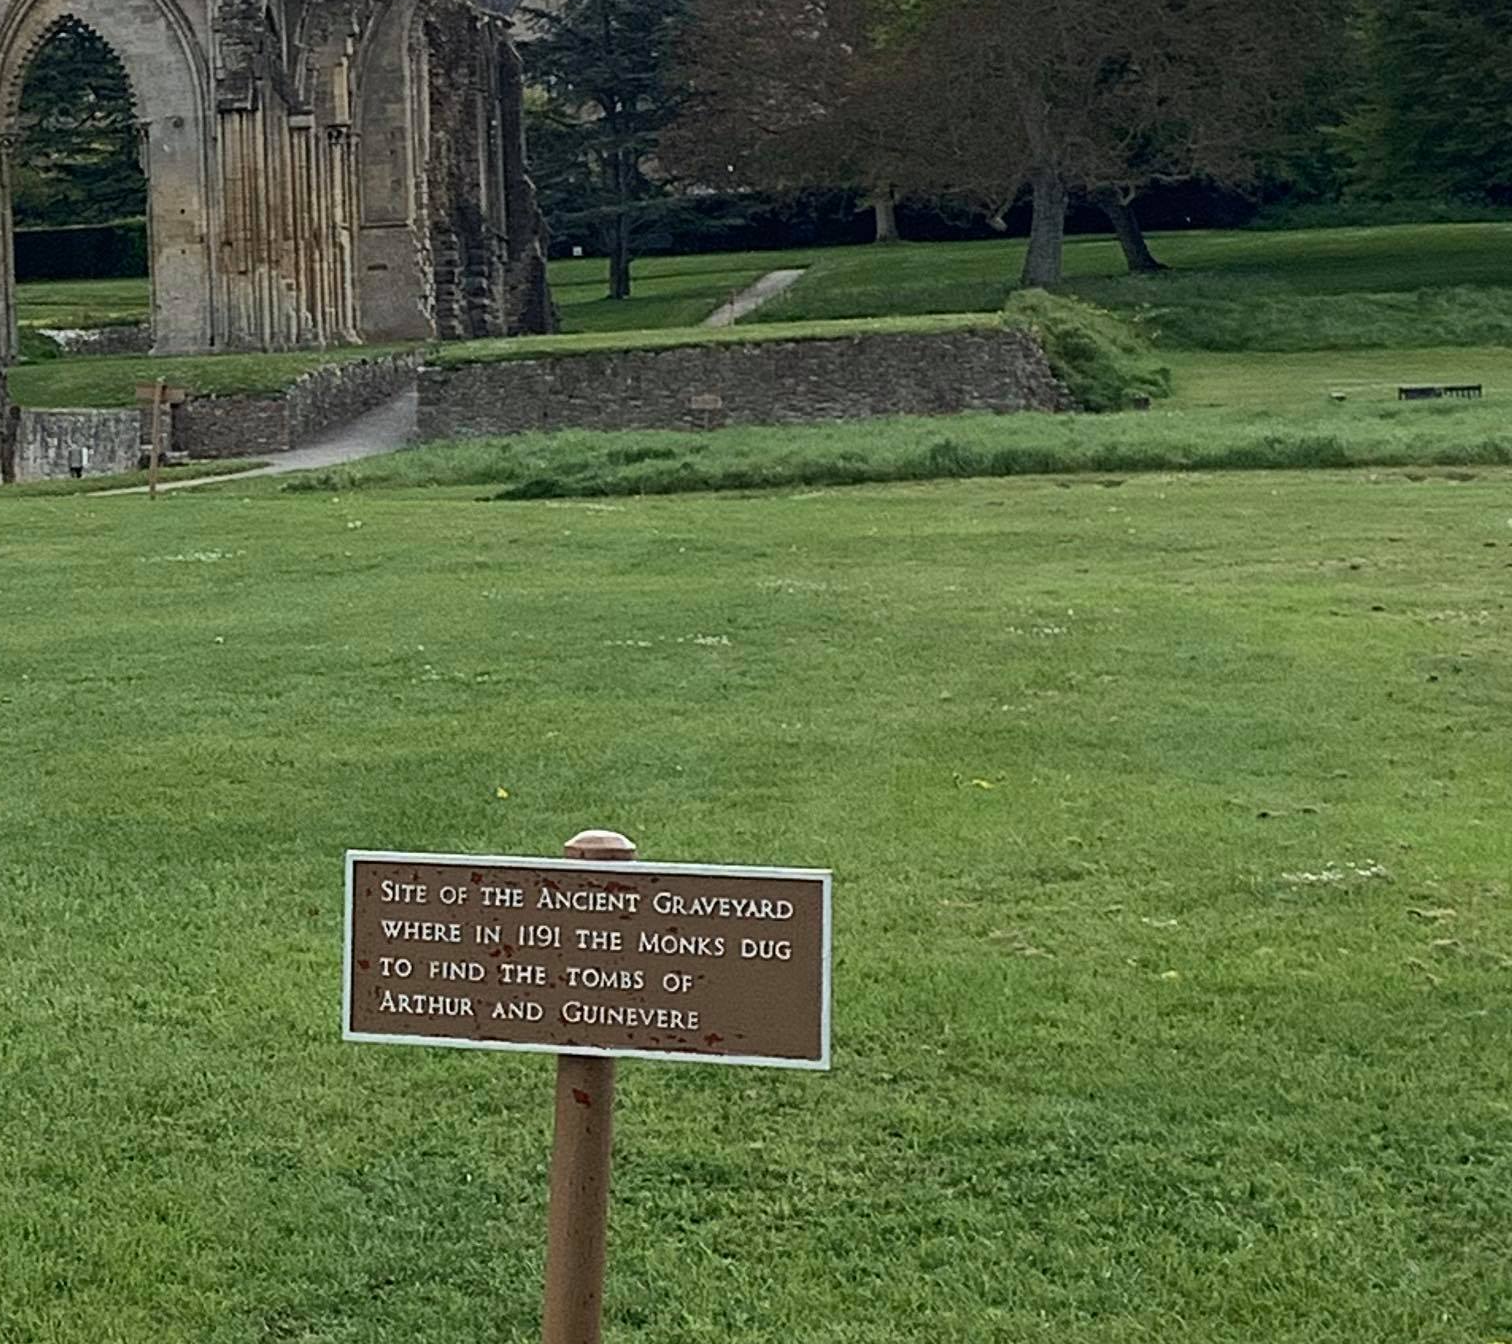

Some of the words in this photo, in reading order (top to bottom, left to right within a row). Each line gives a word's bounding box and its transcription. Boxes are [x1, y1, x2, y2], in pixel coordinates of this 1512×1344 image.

[381, 880, 427, 903] SITE
[439, 886, 467, 905] OF
[480, 886, 524, 908] THE
[536, 887, 641, 913] ANCIENT
[652, 891, 794, 919] GRAVEYARD
[381, 919, 461, 943] WHERE
[476, 925, 501, 945] IN
[518, 925, 561, 948] 1191
[575, 929, 622, 951] THE
[638, 931, 725, 956] MONKS
[741, 938, 792, 960] DUG
[379, 957, 412, 977] TO
[429, 960, 485, 981] FIND
[500, 963, 546, 985] THE
[566, 967, 644, 989] TOMBS
[662, 973, 692, 993] OF
[379, 989, 474, 1016] ARTHUR
[491, 1001, 543, 1021] AND
[562, 1000, 699, 1030] GUINEVERE
